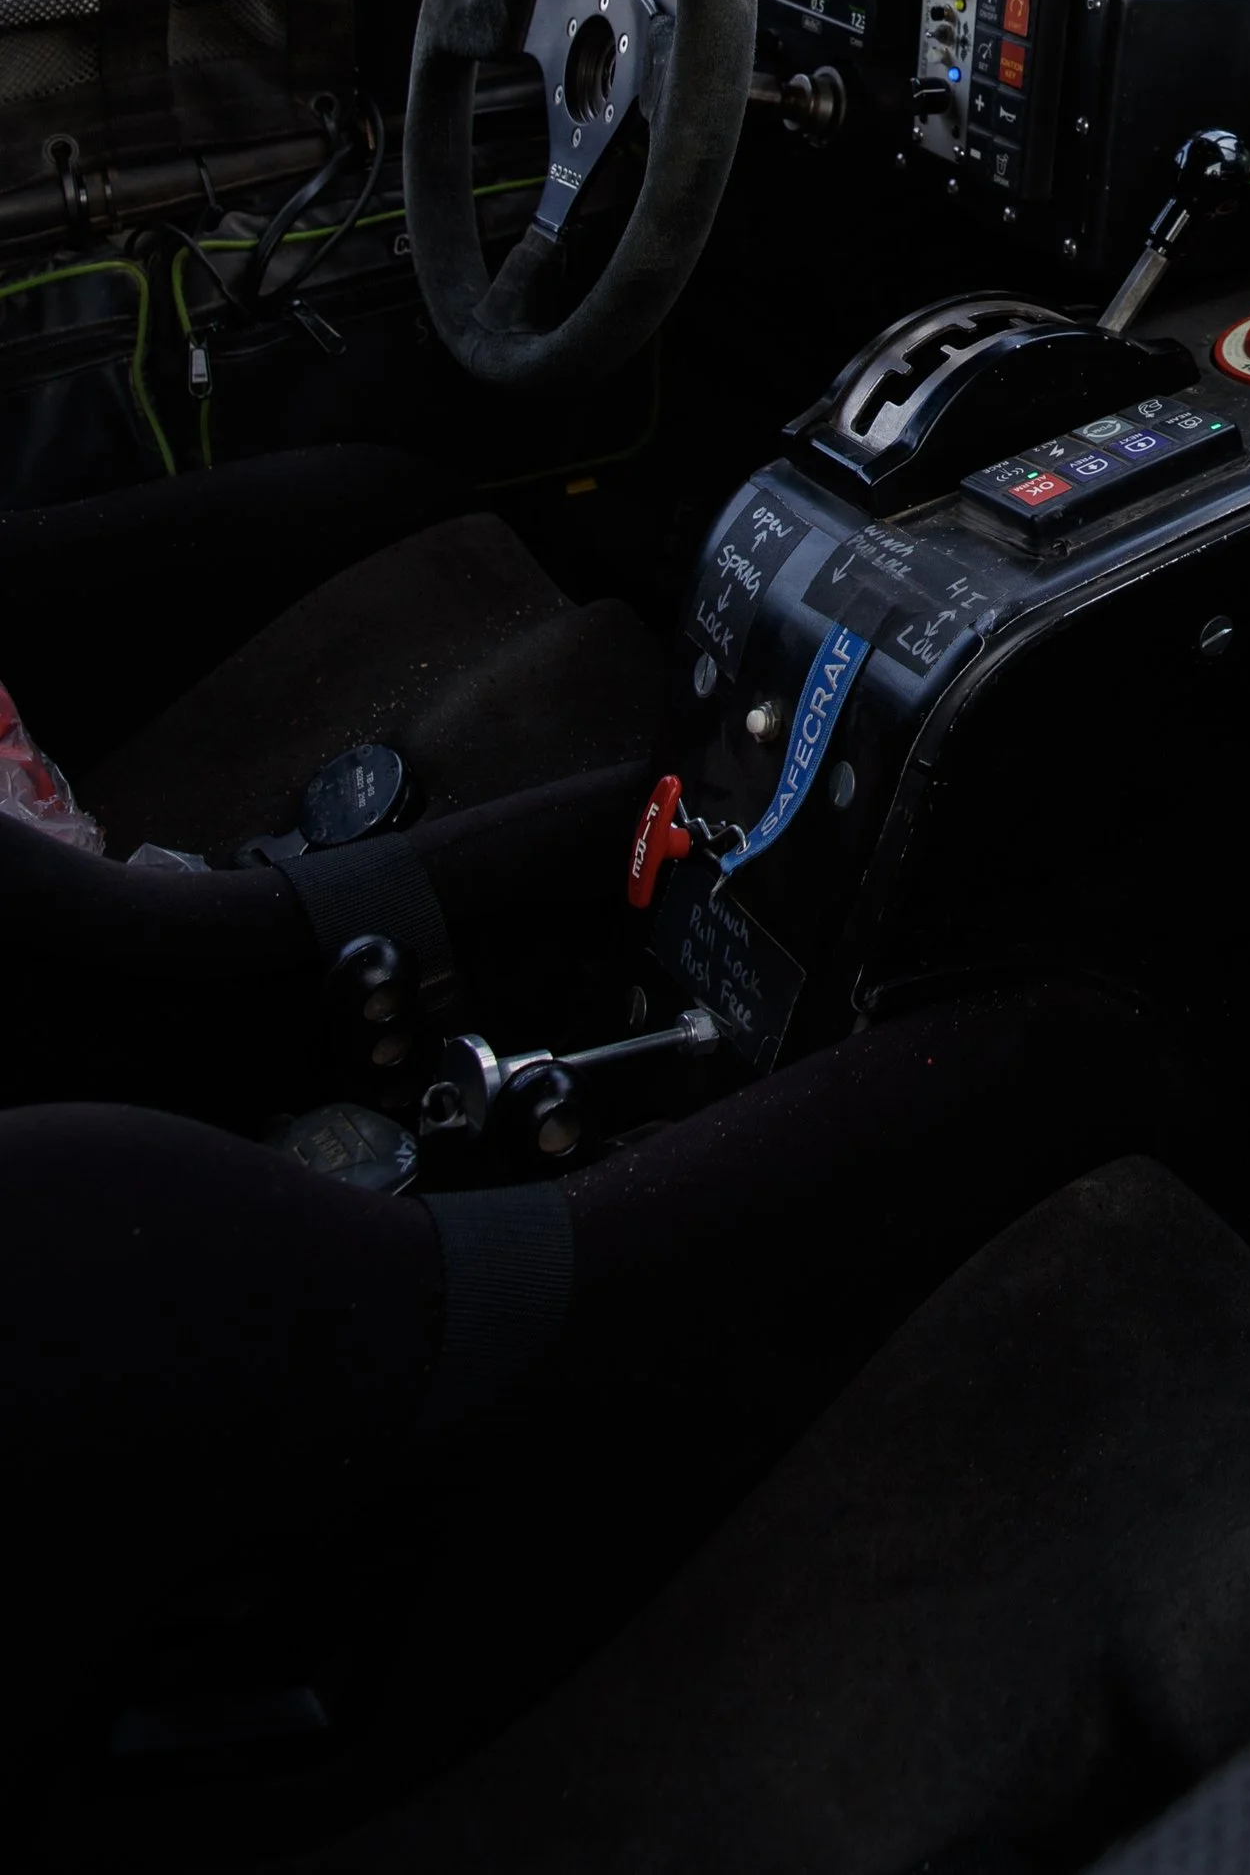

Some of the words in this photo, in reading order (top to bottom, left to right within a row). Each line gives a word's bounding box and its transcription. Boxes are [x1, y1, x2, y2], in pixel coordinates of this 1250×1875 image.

[1119, 432, 1143, 446] NEXT
[1069, 454, 1096, 469] PREV
[1012, 474, 1048, 493] ALARM
[1025, 480, 1055, 497] OK
[696, 600, 734, 657] LOCK
[760, 627, 852, 837] SAFECRAF
[631, 801, 660, 880] FIRE
